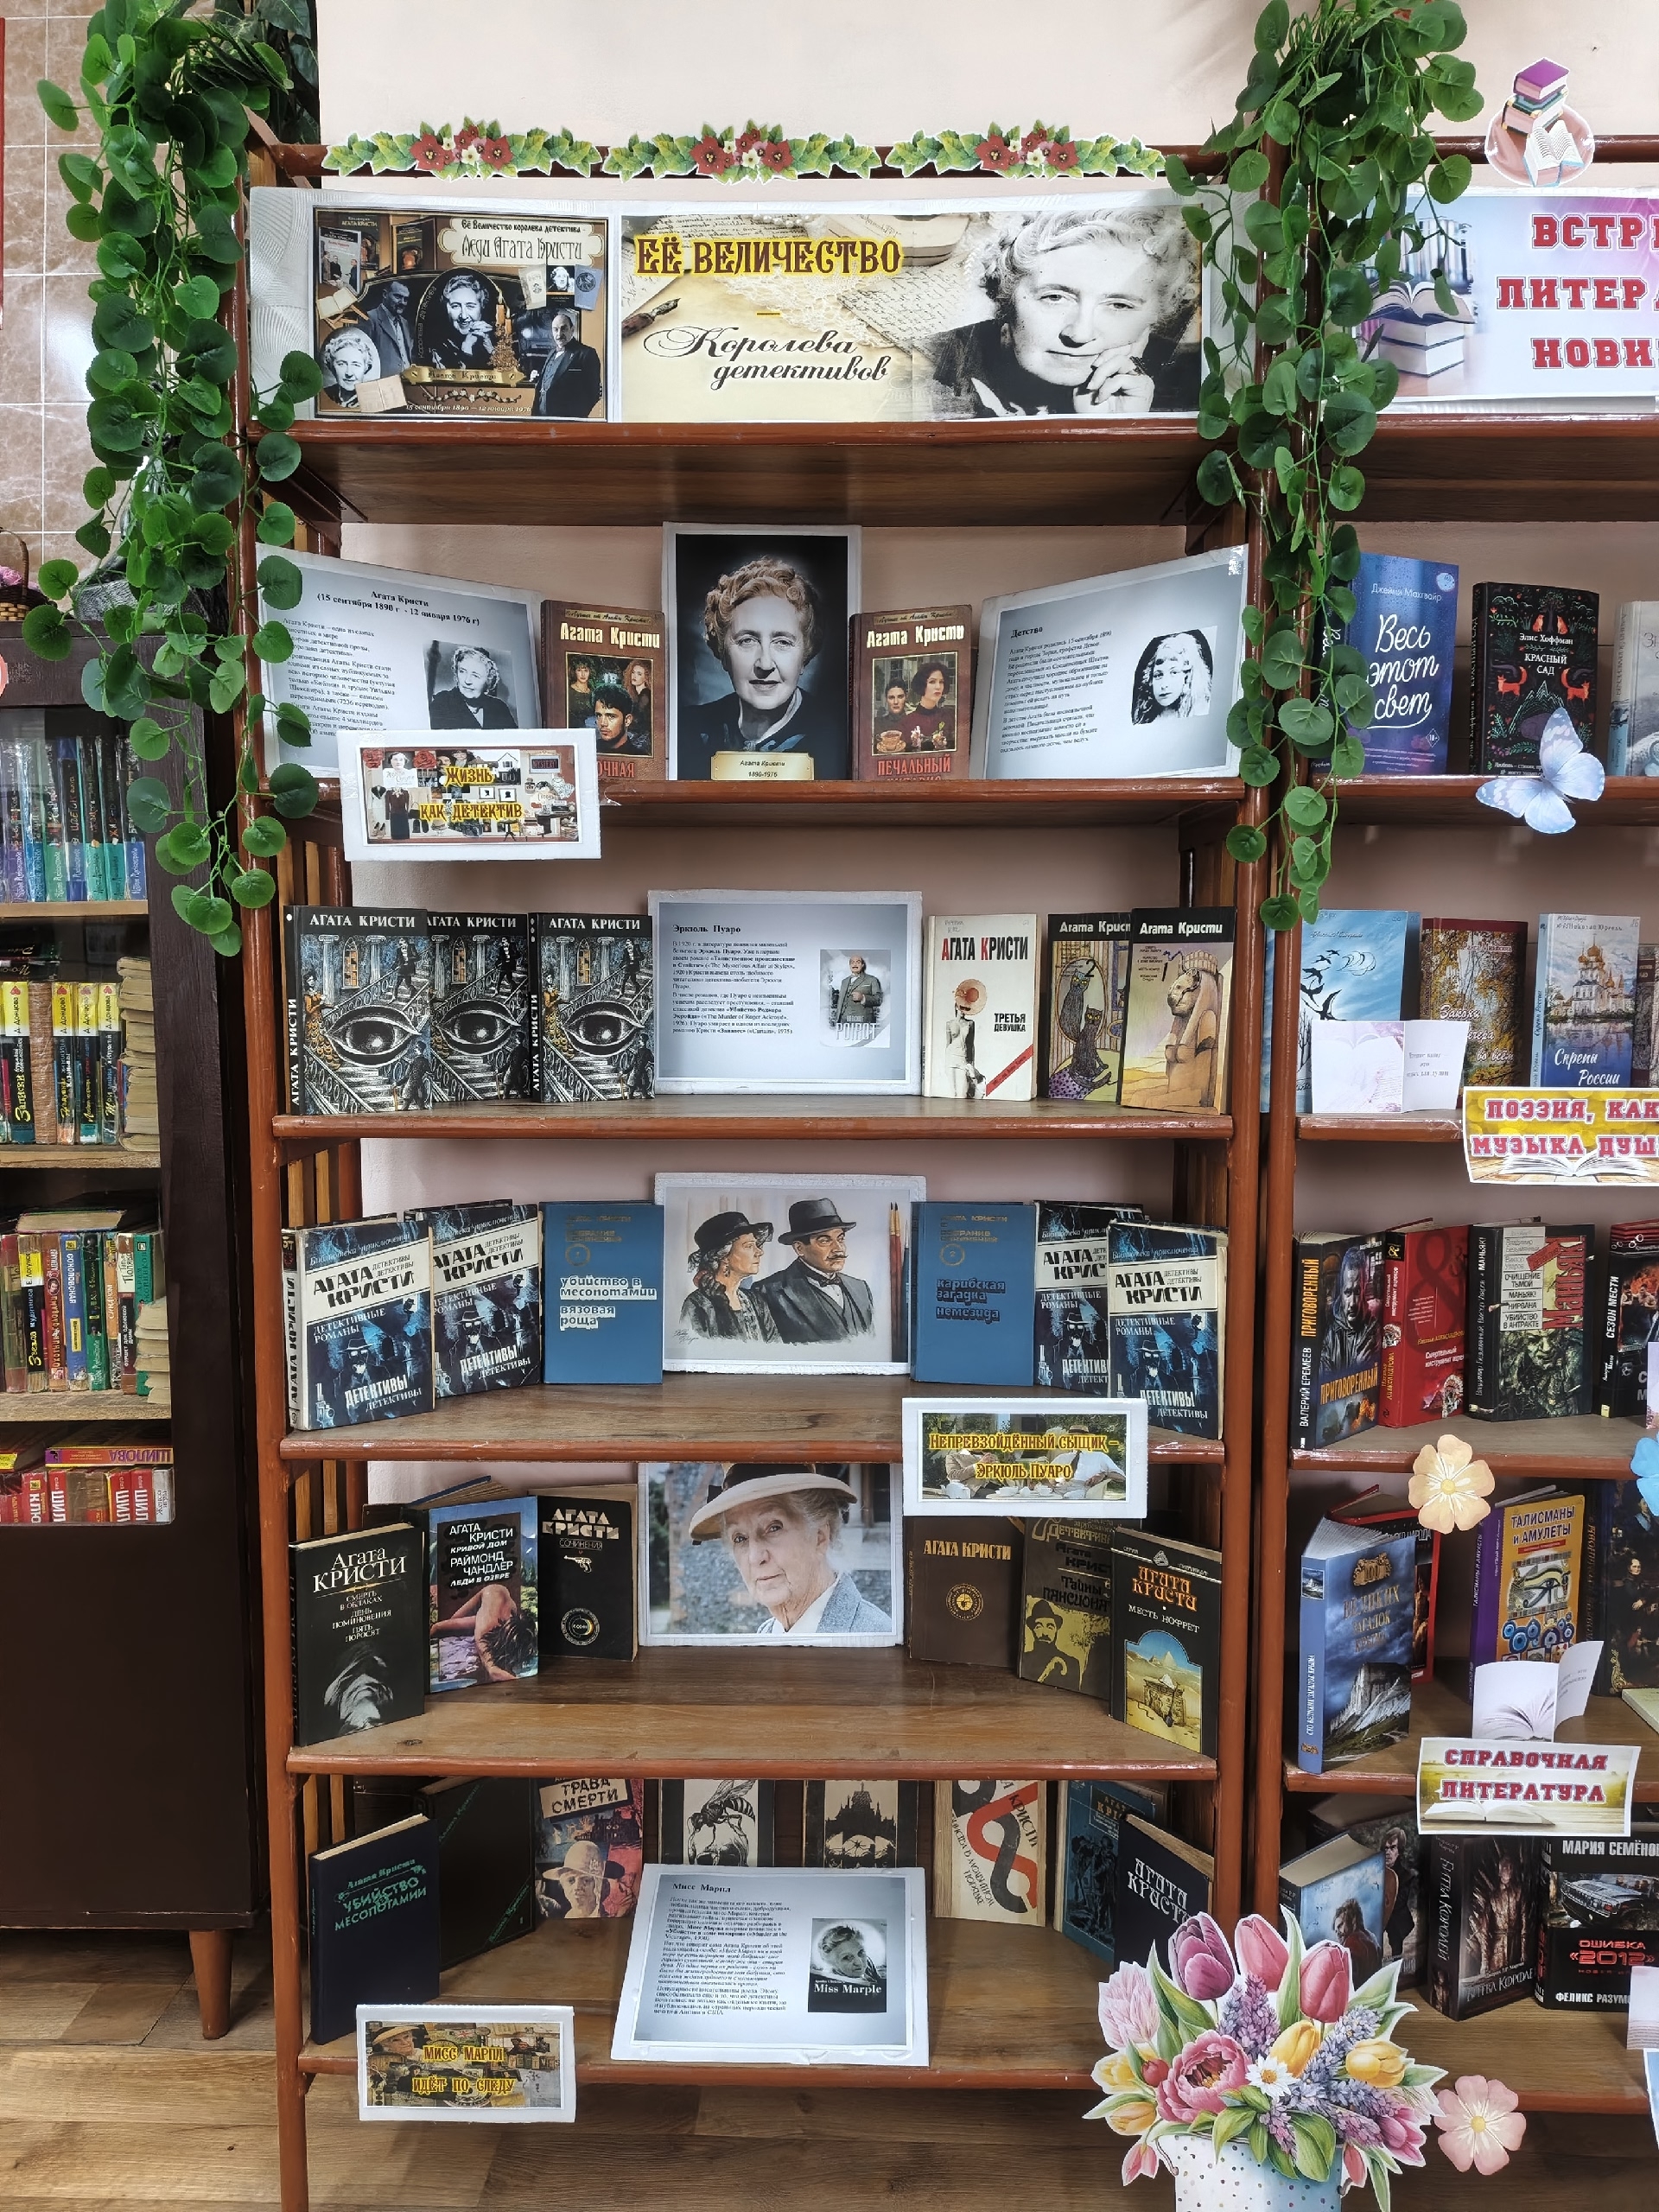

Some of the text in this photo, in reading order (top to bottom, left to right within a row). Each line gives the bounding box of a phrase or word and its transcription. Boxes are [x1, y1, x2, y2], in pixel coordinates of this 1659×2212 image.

[513, 223, 543, 233] королева
[544, 224, 581, 233] детектива
[1532, 213, 1659, 249] ВСТР
[461, 234, 582, 264] Леди Агата Кристи
[638, 238, 902, 274] ЕЁ ВЕЛИЧЕСТВО
[1497, 276, 1659, 310] ЛИТЕР
[643, 324, 855, 359] Королева
[1532, 338, 1659, 369] НОВИ
[713, 355, 889, 391] детективов
[371, 591, 429, 607] Агата Кристи
[1371, 583, 1402, 597] Джейми
[334, 596, 372, 609] сентября
[375, 602, 394, 612] 1890
[421, 611, 450, 621] января
[453, 613, 471, 624] 1976
[560, 622, 660, 649] Агата Кристи
[867, 625, 965, 649] Агата Кристи
[1375, 613, 1431, 652] Весь
[1519, 632, 1573, 645] Элис Хоффман
[1524, 652, 1567, 664] КРАСНЫЙ
[1366, 655, 1440, 687] этот
[1536, 664, 1554, 676] САД
[1375, 684, 1432, 720] свет
[877, 753, 951, 776] ПЕЧАЛЬНЫЙ
[444, 766, 493, 787] ЖИЗНЬ
[419, 803, 523, 822] КАК ДЕТЕКТИВ
[309, 912, 415, 929] АГАТА КРИСТИ
[428, 914, 516, 929] АГАТА КРИСТИ
[549, 917, 640, 931] АГАТА КРИСТИ
[672, 925, 741, 934] Эркюль Пуаро
[1059, 921, 1094, 933] Агата
[1139, 922, 1223, 937] Агата Кристи
[941, 938, 976, 961] АГАТА
[981, 937, 1028, 961] КРИСТИ
[1084, 959, 1095, 977] 2
[994, 1013, 1027, 1024] ТРЕТЬЯ
[994, 1023, 1027, 1033] ДЕВУШКА
[1477, 1047, 1489, 1062] во
[1554, 1048, 1599, 1071] Скрепы
[1578, 1070, 1621, 1087] России
[1486, 1100, 1659, 1122] ПОЭЗИЯ, КАК
[1472, 1136, 1585, 1155] МУЗЫКА
[443, 1239, 524, 1282] КРИСТИ ДЕТЕКТИВЫ
[1043, 1248, 1093, 1266] АГАТА
[1478, 1236, 1487, 1272] МАНЬЯК!
[67, 1253, 77, 1305] СОКОЛОВСКАЯ
[314, 1255, 410, 1296] АГАТА ДЕТЕКТИВЫ
[560, 1275, 641, 1288] убийство в
[937, 1279, 1005, 1290] карибская
[1115, 1268, 1199, 1288] АГАТА ДЕТЕКТИВЫ
[1504, 1272, 1541, 1281] ОЧИЩЕНИЕ
[560, 1287, 656, 1297] месопотамии
[937, 1290, 987, 1303] загадка
[1040, 1290, 1102, 1300] ДЕТЕКТИВНЫЕ
[1127, 1276, 1203, 1304] КРИСТИ ДЕТЕКТИВЫ
[1509, 1290, 1537, 1299] МАНЬЯК!
[1608, 1275, 1619, 1307] МЕСТИ
[560, 1306, 615, 1315] вязовая
[937, 1306, 1000, 1319] немезида
[1040, 1300, 1078, 1310] РОМАНЫ
[1508, 1301, 1537, 1310] НИРВАНА
[313, 1308, 386, 1337] ДЕТЕКТИВНЫЕ
[560, 1316, 597, 1327] роща
[1115, 1318, 1175, 1327] ДЕТЕКТИВНЫЕ
[1504, 1313, 1538, 1321] УБИЙСТВО
[1509, 1321, 1540, 1330] АНТРАКТЕ
[1605, 1308, 1618, 1339] СЕЗОН
[314, 1323, 359, 1344] РОМАНЫ
[1116, 1326, 1153, 1336] РОМАНЫ
[29, 1331, 41, 1367] Звезда
[1300, 1258, 1319, 1427] ВАЛЕРИЙ ЕРЕМЕЕВ ПРИГОВОРЕННЫЙ
[344, 1374, 408, 1409] ДЕТЕКТИВЫ
[1320, 1363, 1379, 1406] ПРИГОВОРЕННЫЙ
[365, 1387, 423, 1413] ДЕТЕКТИВЫ
[930, 1433, 1108, 1452] НЕПРЕВЗОЙДЁННЫЙ СЫЩИК
[109, 1449, 171, 1463] ШИЛОВА
[976, 1463, 1072, 1479] ЭРКЮЛЬ ПУАРО
[1511, 1506, 1574, 1527] ТАЛИСМАНЫ
[449, 1522, 481, 1536] АГАТА
[469, 1528, 514, 1542] КРИСТИ
[1522, 1523, 1572, 1544] АМУЛЕТЫ
[450, 1539, 508, 1554] КРИВОЙ ДОМ
[559, 1538, 603, 1550] СОЧИНЕНИЯ
[923, 1540, 1012, 1560] АГАТА КРИСТИ
[332, 1548, 386, 1571] Агата
[450, 1550, 505, 1568] РАЙМОНД
[463, 1560, 514, 1576] ЧАНДЛЕР
[313, 1556, 407, 1593] КРИСТИ
[450, 1571, 512, 1587] ЛЕДИ В ОЗЕРЕ
[346, 1590, 377, 1603] СМЕРТЬ
[346, 1595, 383, 1610] ОБЛАКАХ
[1132, 1578, 1198, 1612] КРИСТИ
[1344, 1585, 1400, 1619] ВЕЛИКИХ
[332, 1609, 391, 1630] ПОМИНОВЕНИЯ
[350, 1607, 372, 1618] ДЕНЬ
[1128, 1604, 1201, 1633] МЕСТЬ НОФРЕТ
[345, 1628, 380, 1642] ПОРОСЯТ
[352, 1624, 373, 1635] ПЯТЬ
[1444, 1749, 1608, 1770] СПРАВОЧНАЯ
[1441, 1781, 1605, 1802] ЛИТЕРАТУРА
[552, 1789, 619, 1815] СМЕРТИ
[1562, 1840, 1605, 1855] МАРИЯ
[342, 1876, 420, 1913] УБИЙСТВО
[701, 1883, 731, 1892] Марпл
[334, 1885, 427, 1932] МЕСОПОТАМИИ
[1578, 1939, 1646, 1949] ОШИБКА
[1569, 1949, 1656, 1966] «2012»
[814, 1984, 882, 1996] Miss Marple
[1555, 1992, 1593, 2004] ФЕЛИКС
[423, 2046, 505, 2063] МИСС МАРПЛ
[412, 2076, 516, 2095] ИДЁТ ПО СЛЕДУ
